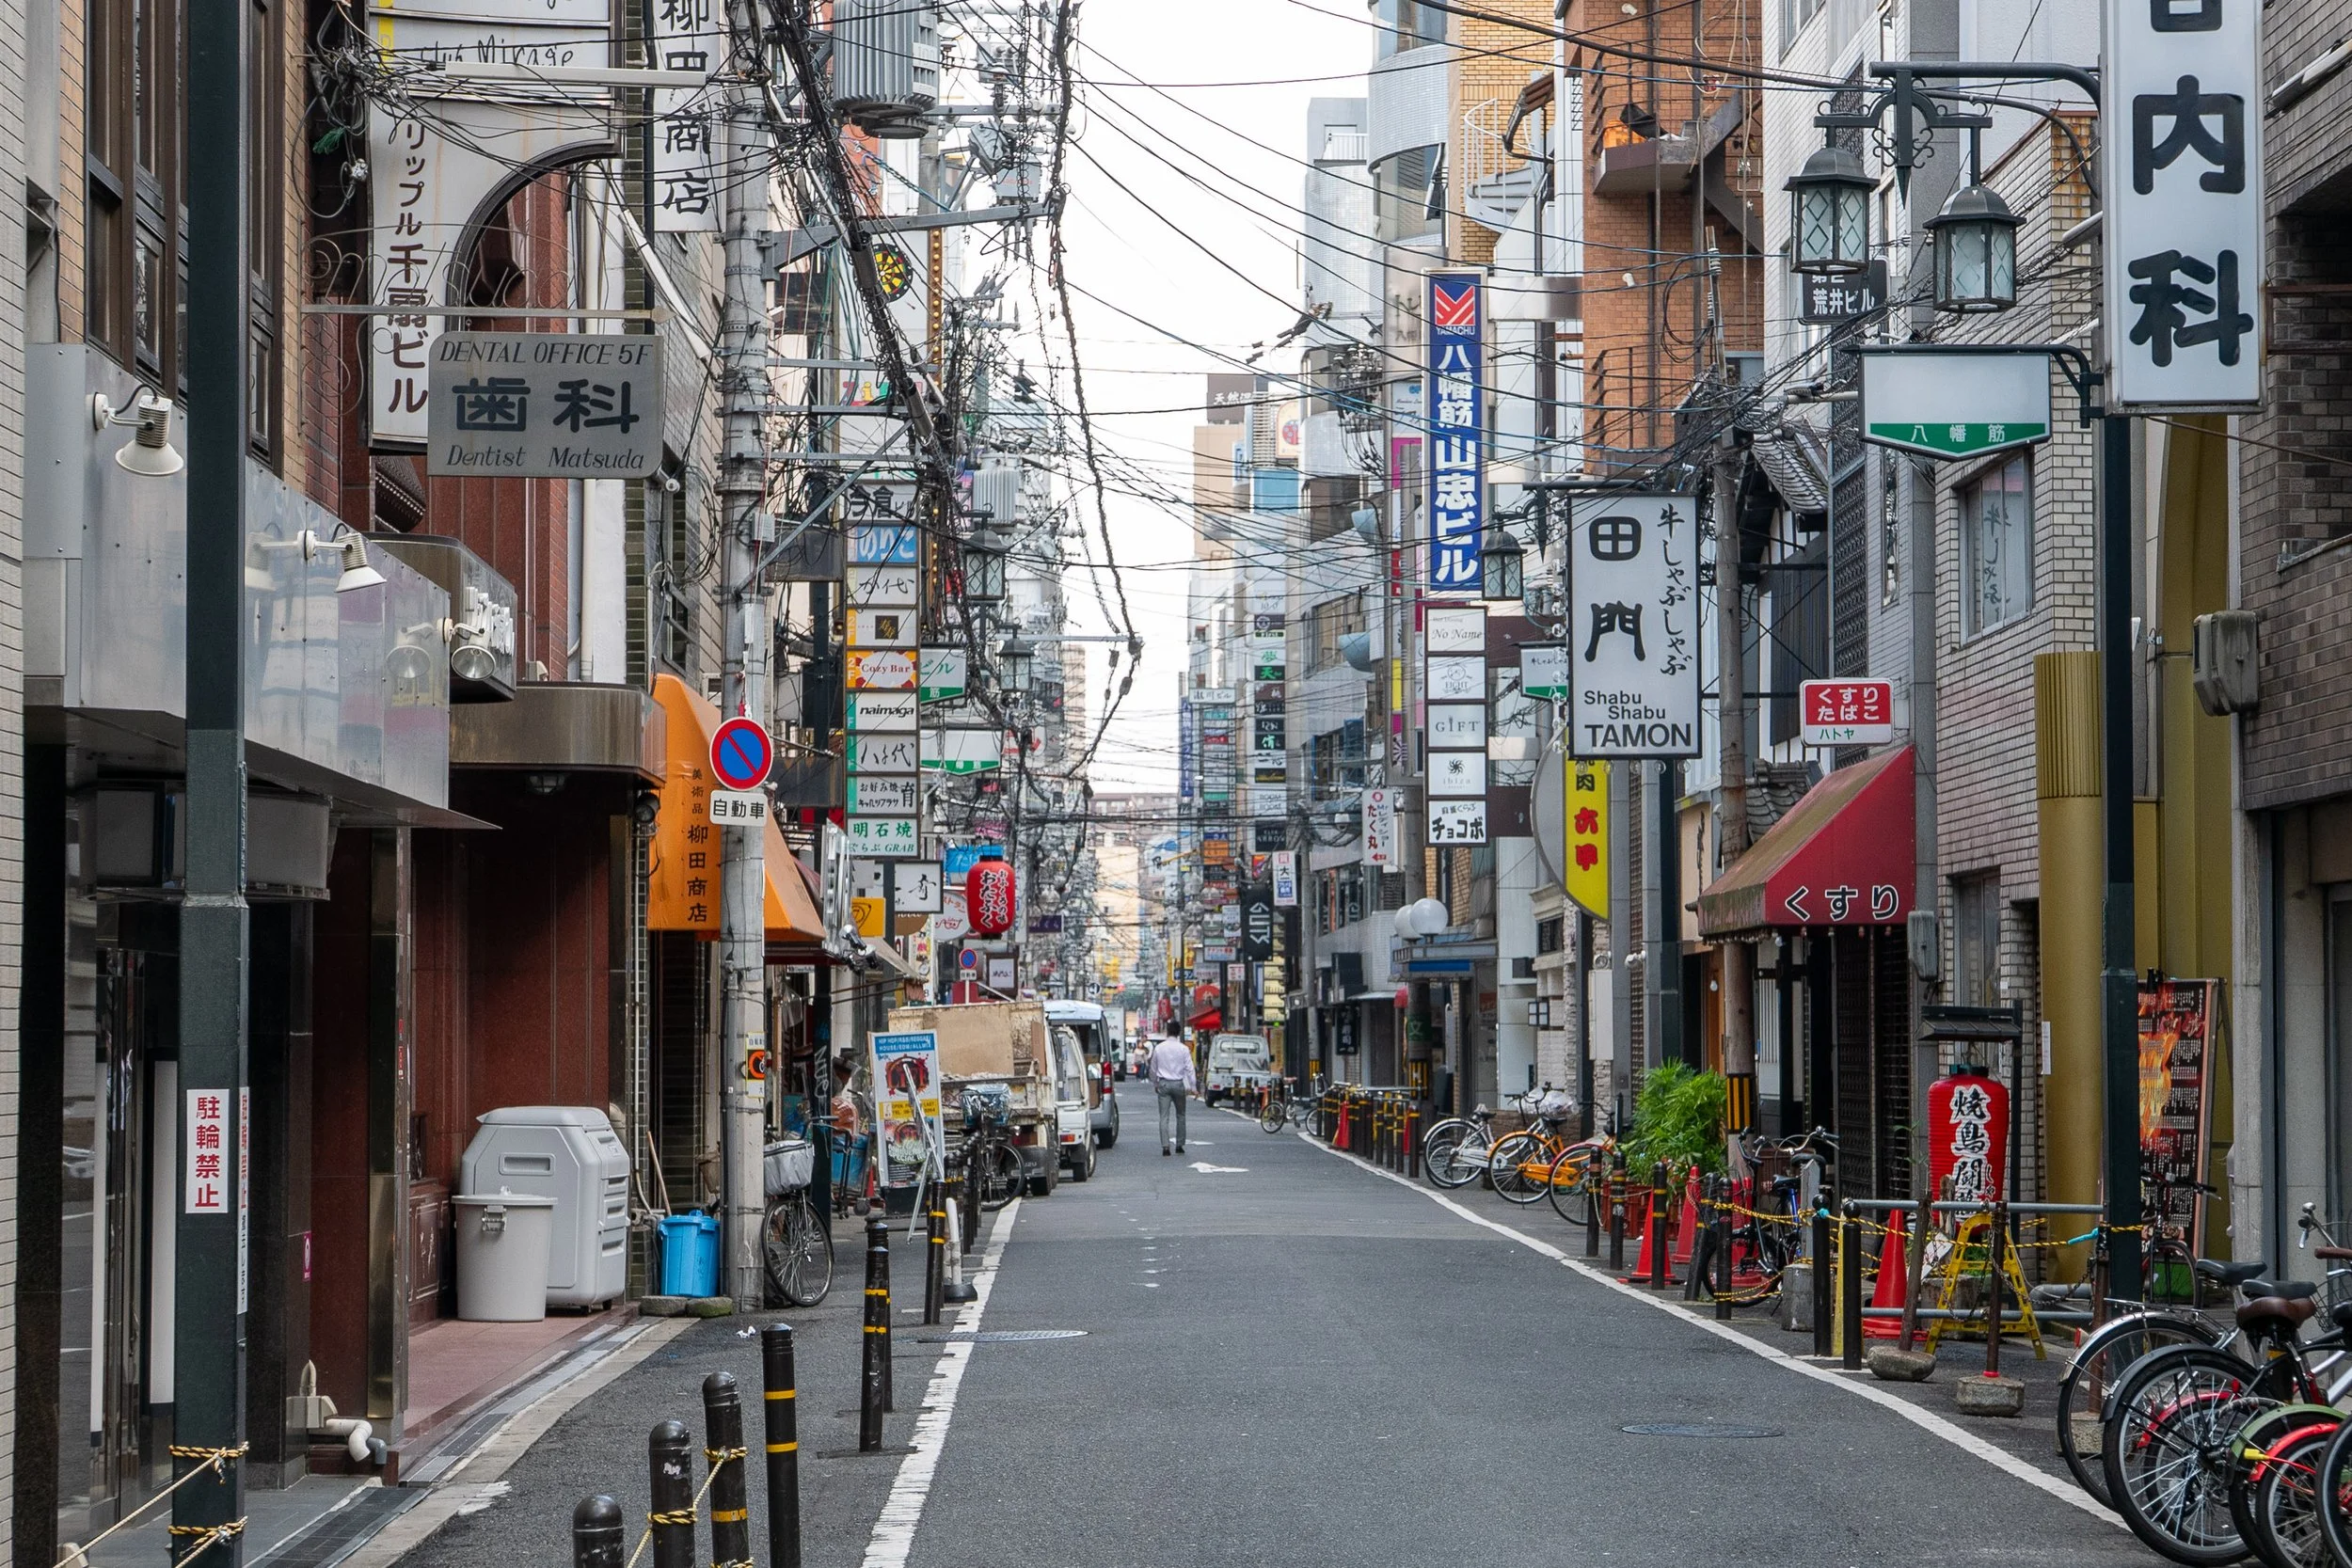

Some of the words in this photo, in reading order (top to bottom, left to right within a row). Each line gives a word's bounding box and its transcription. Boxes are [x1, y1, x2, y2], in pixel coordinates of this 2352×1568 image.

[1813, 288, 1875, 315] 荒井ビル
[1436, 326, 1476, 336] YAMACHU
[439, 341, 526, 363] DENTAL
[533, 341, 613, 365] OFFICE
[618, 342, 654, 366] 5F
[1911, 424, 2007, 443] 八幡筋
[446, 444, 527, 467] Dentist
[548, 447, 645, 470] Matsuda
[1435, 344, 1479, 583] 八幡筋山忠ビル
[859, 527, 914, 561] のりこ
[1656, 502, 1693, 676] 牛しゃぶしゃぶ
[1432, 628, 1449, 640] No
[1450, 628, 1484, 640] Name
[861, 664, 889, 675] Cozy
[891, 664, 911, 674] Bar
[1583, 690, 1642, 705] Shabu
[1818, 687, 1879, 705] くすり
[860, 705, 914, 719] naimaga
[1608, 705, 1666, 720] Shabu
[1817, 705, 1880, 722] たばこ
[1435, 715, 1481, 733] GIFT
[1584, 722, 1692, 748] TAMON
[1820, 728, 1854, 741] ハトヤ
[691, 768, 705, 816] 美術品
[859, 783, 899, 793] お好み焼
[900, 781, 914, 808] 育
[713, 799, 765, 820] 自動車
[853, 821, 913, 839] 明石焼
[1367, 803, 1378, 850] たく丸
[1431, 816, 1485, 841] チョコボ
[884, 843, 914, 853] GRAB
[687, 824, 708, 924] 柳田商店
[979, 870, 998, 929] おたふく
[1784, 883, 1900, 922] くすり
[195, 1096, 221, 1209] 駐輪禁止
